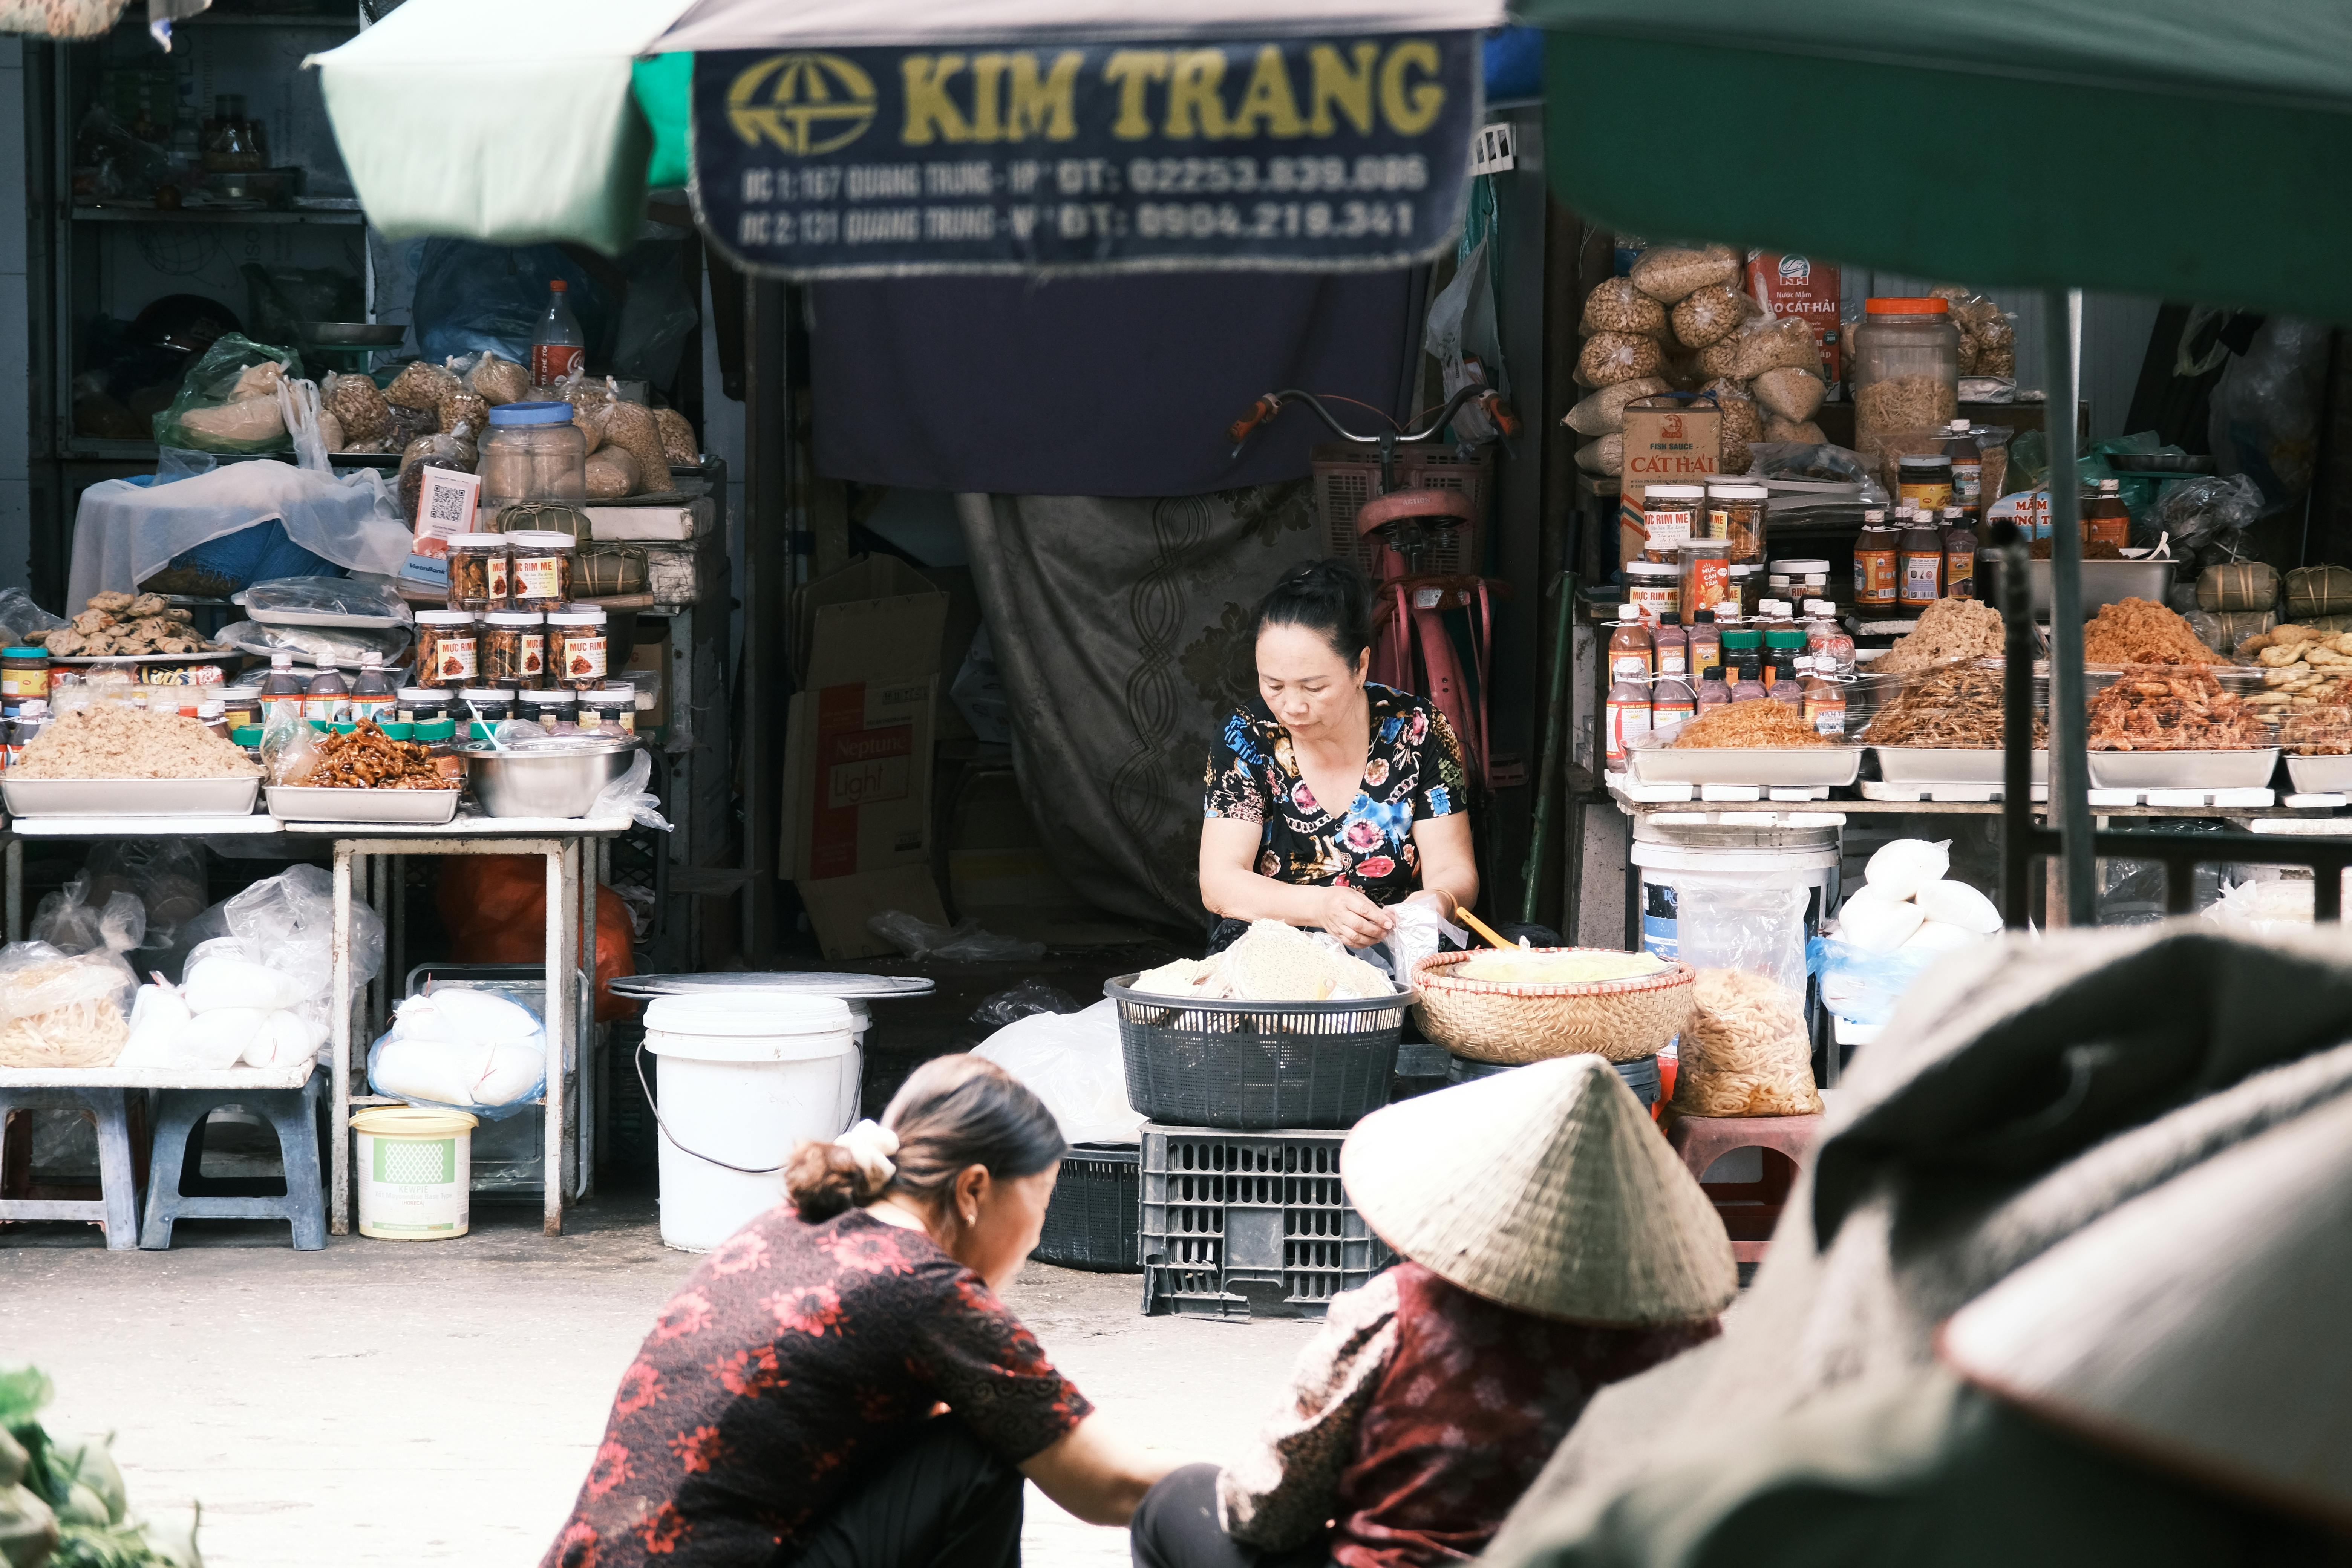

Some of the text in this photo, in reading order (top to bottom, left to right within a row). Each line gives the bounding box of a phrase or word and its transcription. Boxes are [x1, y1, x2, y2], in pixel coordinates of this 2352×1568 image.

[900, 40, 1447, 146] KIM TRANG
[846, 164, 921, 201] QUANG
[925, 162, 993, 197] TRUNG
[844, 208, 920, 244] QUANG
[925, 206, 996, 241] TRUNG
[245, 228, 261, 261] ISO
[1786, 300, 1810, 313] CÁT
[1813, 299, 1835, 312] HẢI
[1631, 454, 1672, 473] CÁT
[1402, 497, 1431, 505] ACTION
[2016, 496, 2047, 510] MẮM
[1656, 514, 1673, 524] RIM
[1676, 513, 1689, 524] ME
[1714, 514, 1723, 524] ME
[409, 563, 446, 574] VietinBank
[524, 562, 538, 571] RIM
[540, 562, 553, 571] ME
[1632, 591, 1677, 602] MỰC RIM ME
[1792, 588, 1806, 597] RIM
[442, 643, 459, 654] MỰC
[461, 642, 472, 651] RIM
[526, 640, 539, 650] MỰC
[570, 642, 587, 653] MỰC
[590, 641, 602, 651] RIM
[837, 735, 908, 759] Neptune
[835, 763, 884, 802] Light
[386, 1192, 423, 1201] Mayonnaise
[441, 1193, 452, 1201] Type
